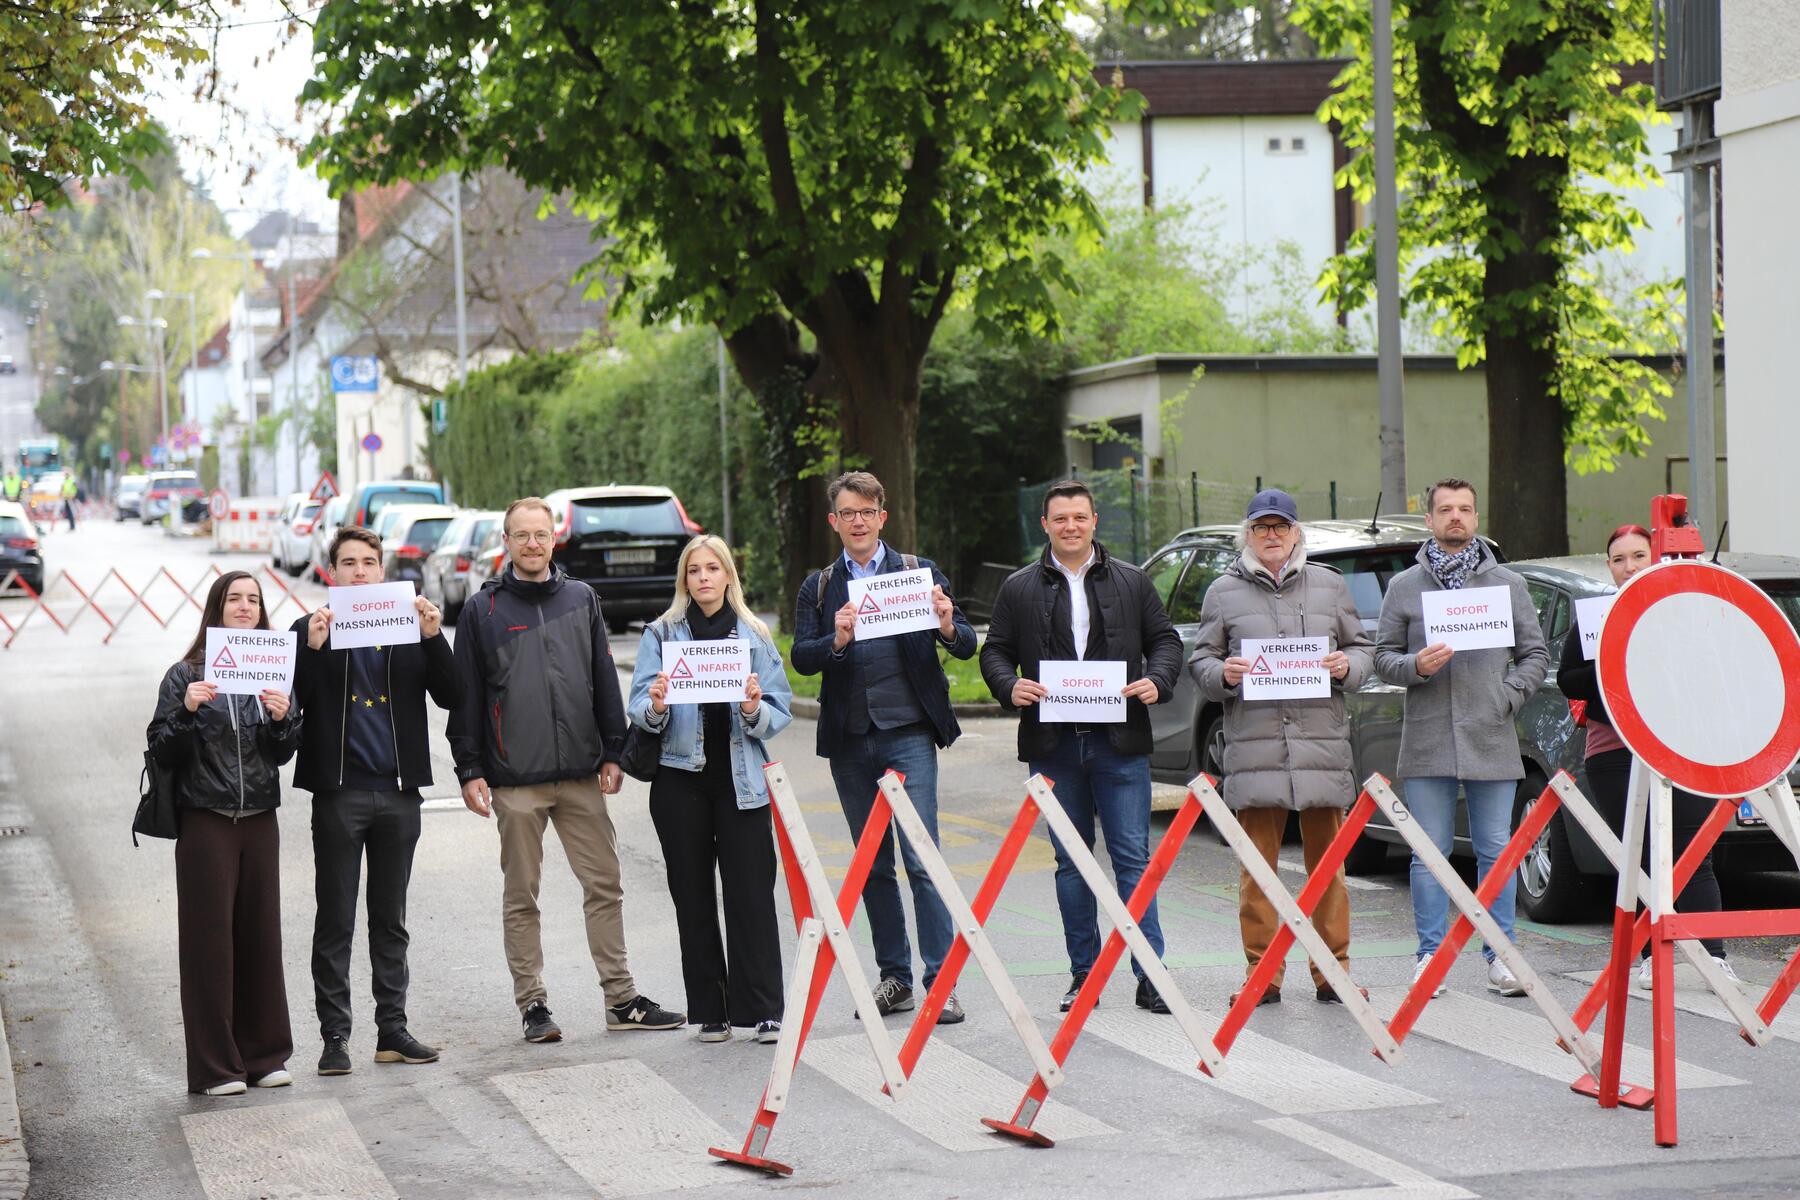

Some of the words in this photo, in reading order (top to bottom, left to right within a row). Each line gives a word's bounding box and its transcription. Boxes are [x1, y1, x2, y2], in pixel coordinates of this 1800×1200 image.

[866, 576, 926, 591] VERKEHRS-
[884, 592, 928, 606] INFARKT
[352, 601, 396, 613] SOFORT
[1446, 604, 1489, 616] SOFORT
[860, 608, 930, 625] VERHINDERN
[335, 616, 414, 631] MASSNAHMEN
[1430, 620, 1508, 634] MASSNAHMEN
[227, 635, 290, 648] VERKEHRS-
[682, 646, 742, 656] VERKEHRS-
[1261, 644, 1322, 654] VERKEHRS-
[242, 654, 287, 666] INFARKT
[1276, 659, 1321, 669] INFARKT
[697, 663, 742, 672] INFARKT
[214, 669, 287, 683] VERHINDERN
[1251, 675, 1322, 686] VERHINDERN
[672, 679, 743, 690] VERHINDERN
[1062, 678, 1104, 688] SOFORT
[1045, 695, 1122, 704] MASSNAHMEN
[628, 1008, 646, 1022] N
